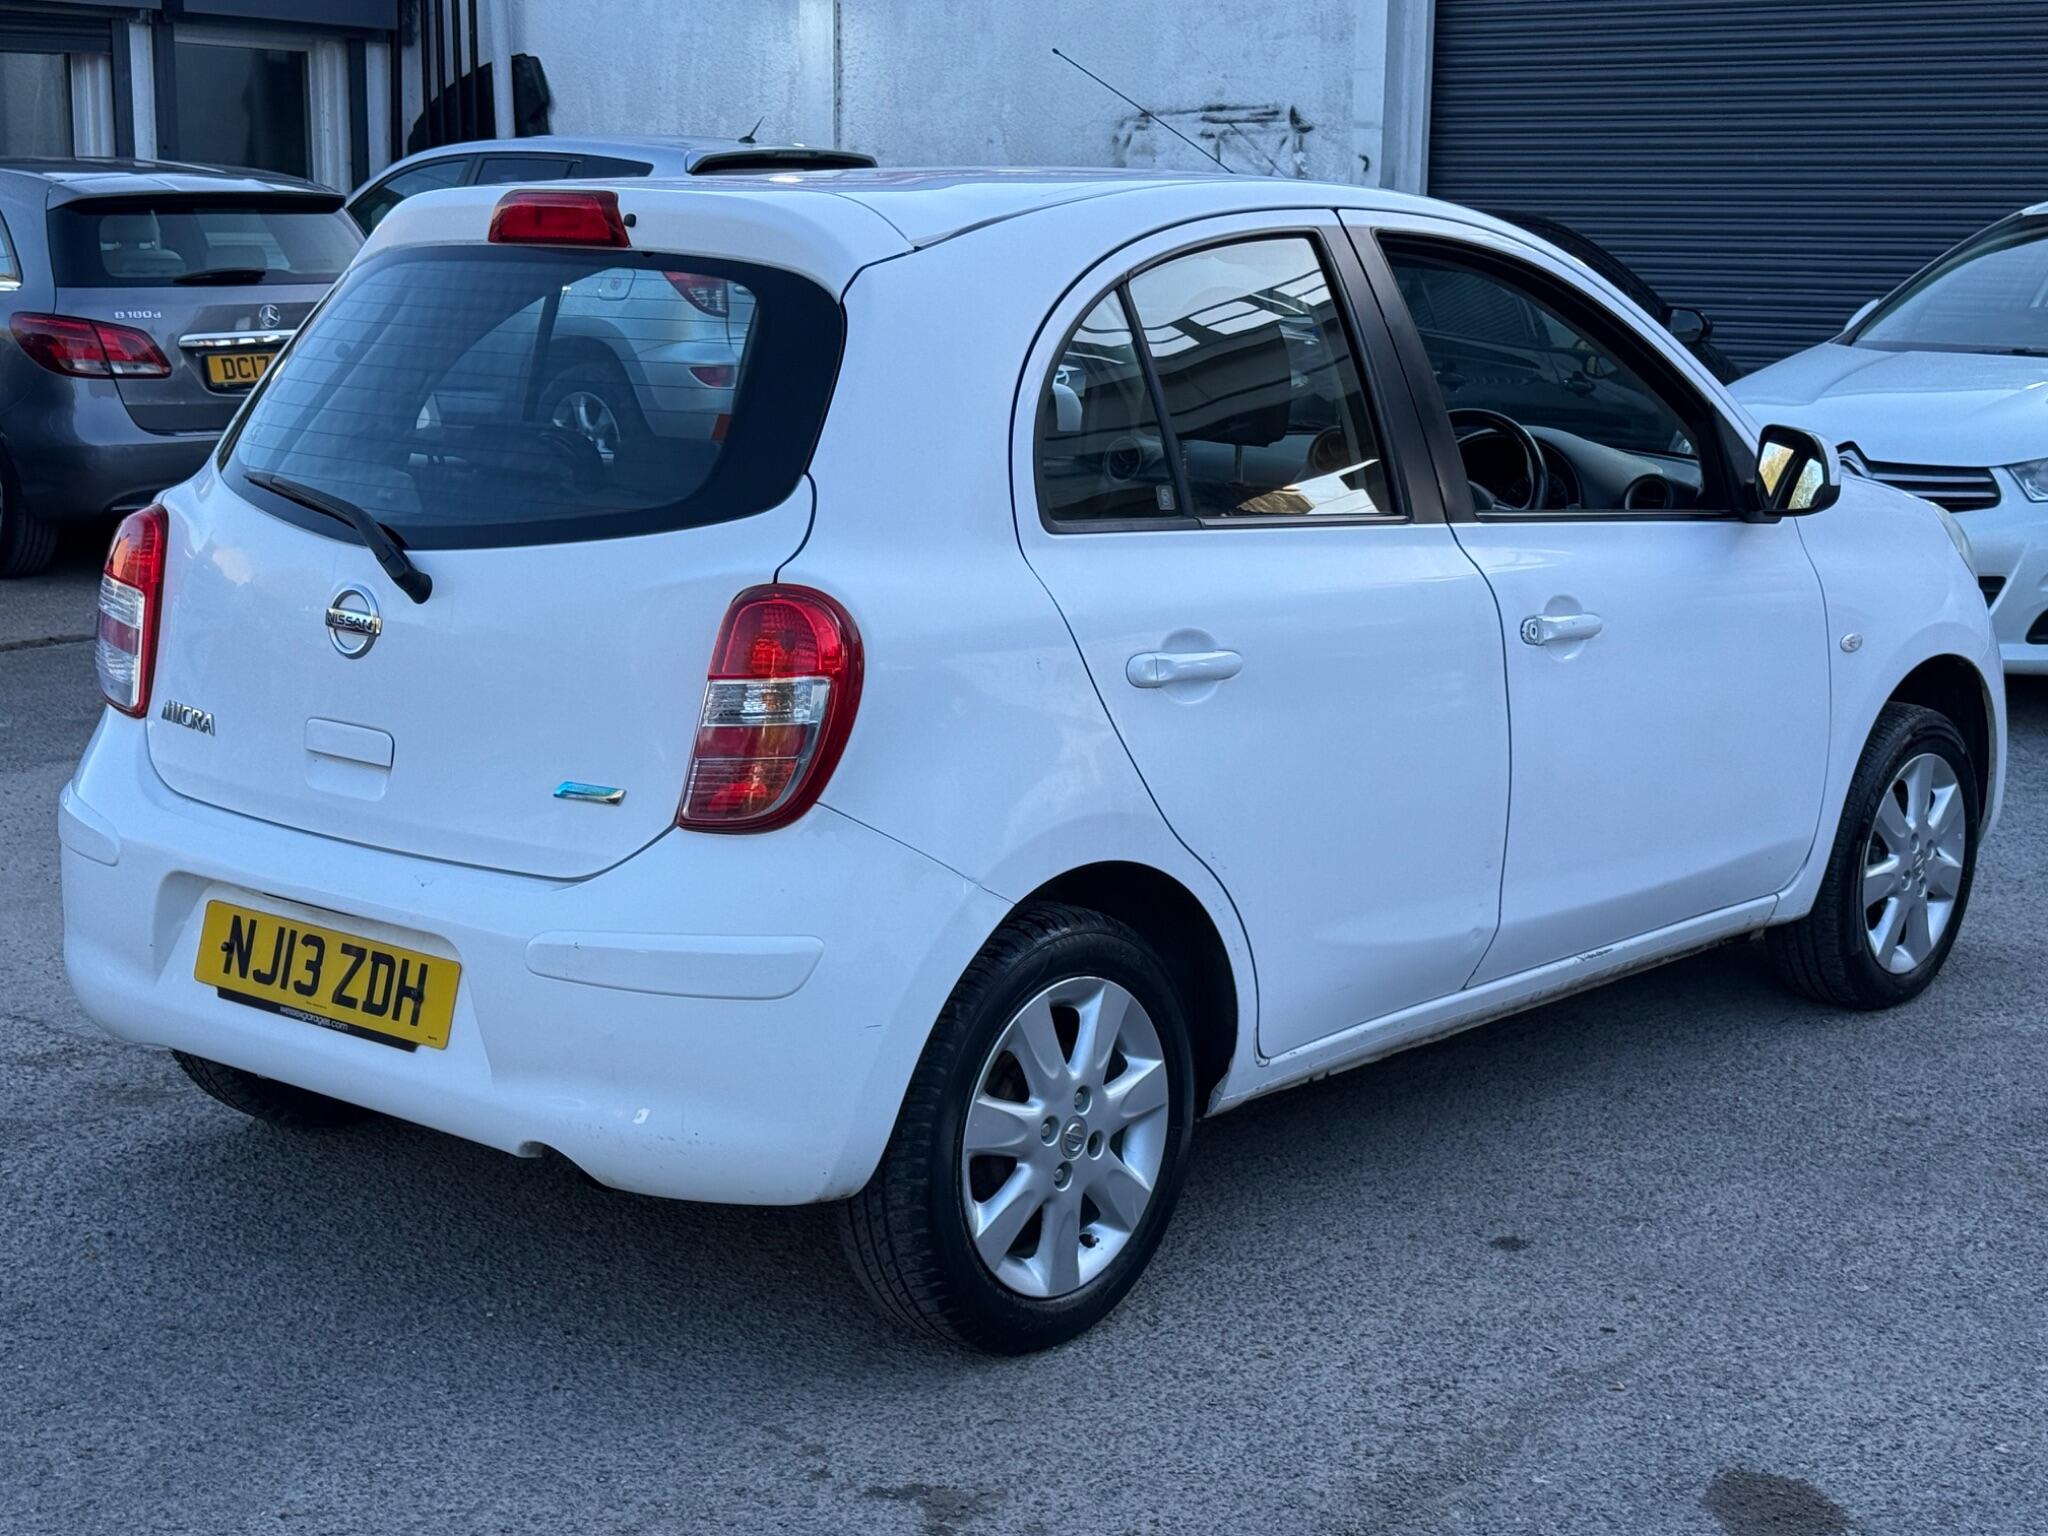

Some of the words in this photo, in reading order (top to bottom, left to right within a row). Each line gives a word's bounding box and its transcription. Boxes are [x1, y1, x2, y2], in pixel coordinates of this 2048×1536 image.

[326, 611, 374, 633] NISSAN
[162, 700, 216, 737] MICRA
[223, 915, 326, 997] NJ13
[331, 943, 428, 1026] ZDH
